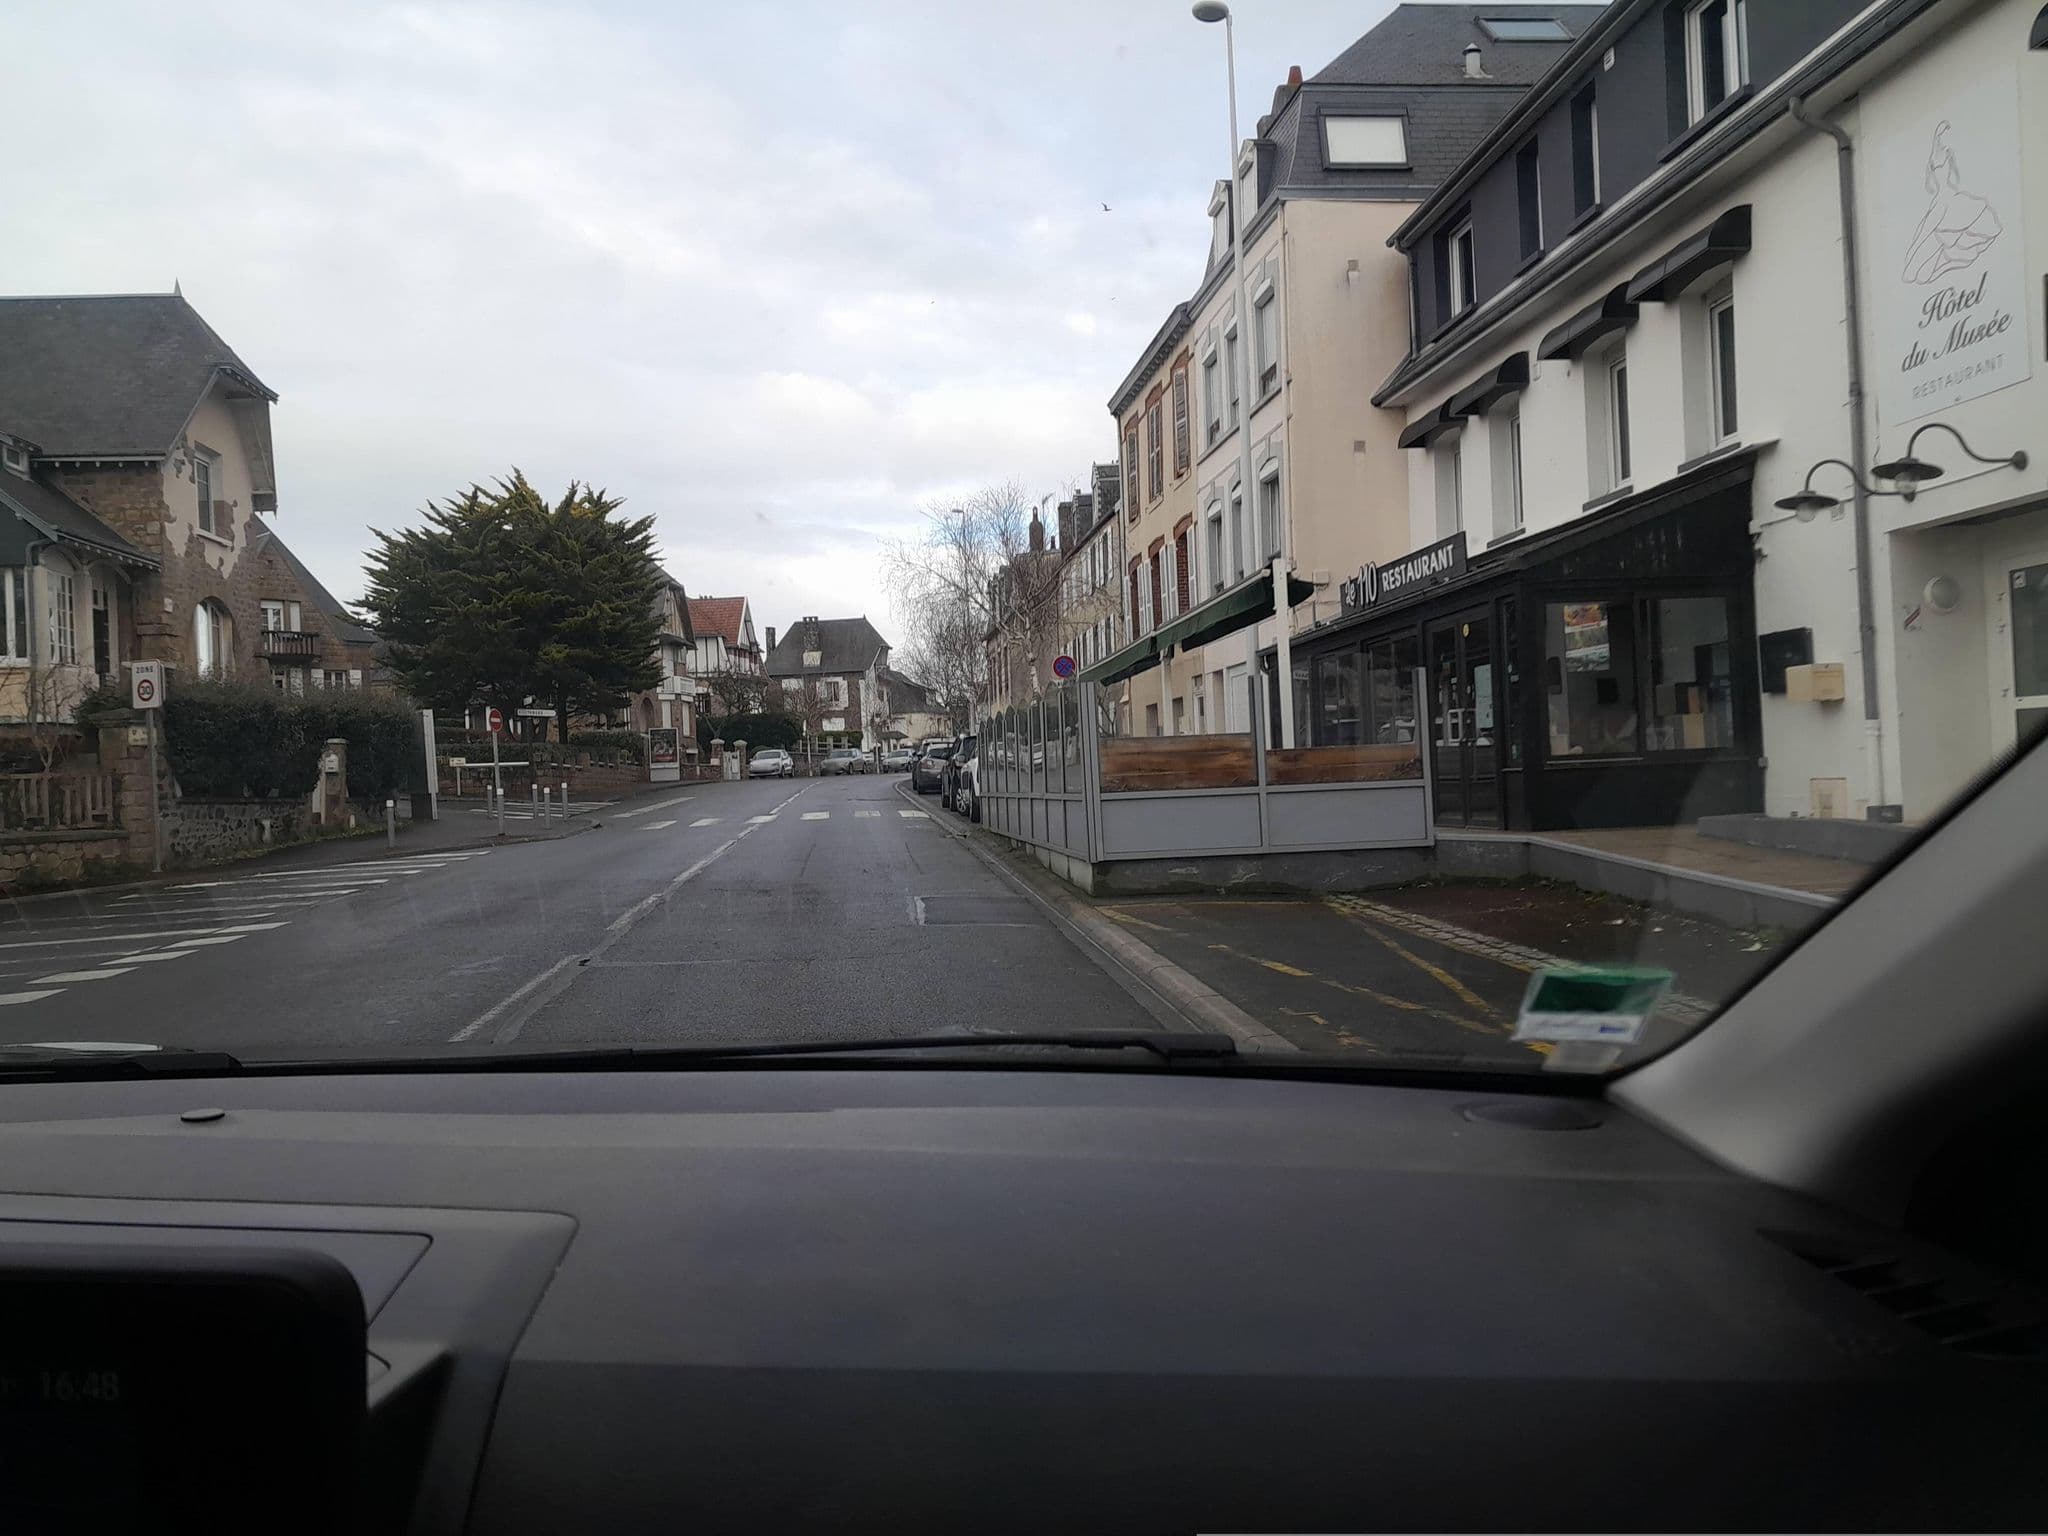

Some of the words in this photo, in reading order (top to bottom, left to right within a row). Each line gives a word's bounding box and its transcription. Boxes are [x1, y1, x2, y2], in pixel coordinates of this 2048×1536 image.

[1918, 270, 1988, 328] Hôtel
[1901, 340, 1929, 372] du
[1932, 309, 2013, 360] Musée
[1913, 353, 2005, 399] RESTAURANT
[1358, 562, 1377, 606] 110
[1382, 544, 1454, 592] RESTAURANT
[140, 685, 152, 696] 30
[39, 1368, 120, 1401] 16:48
